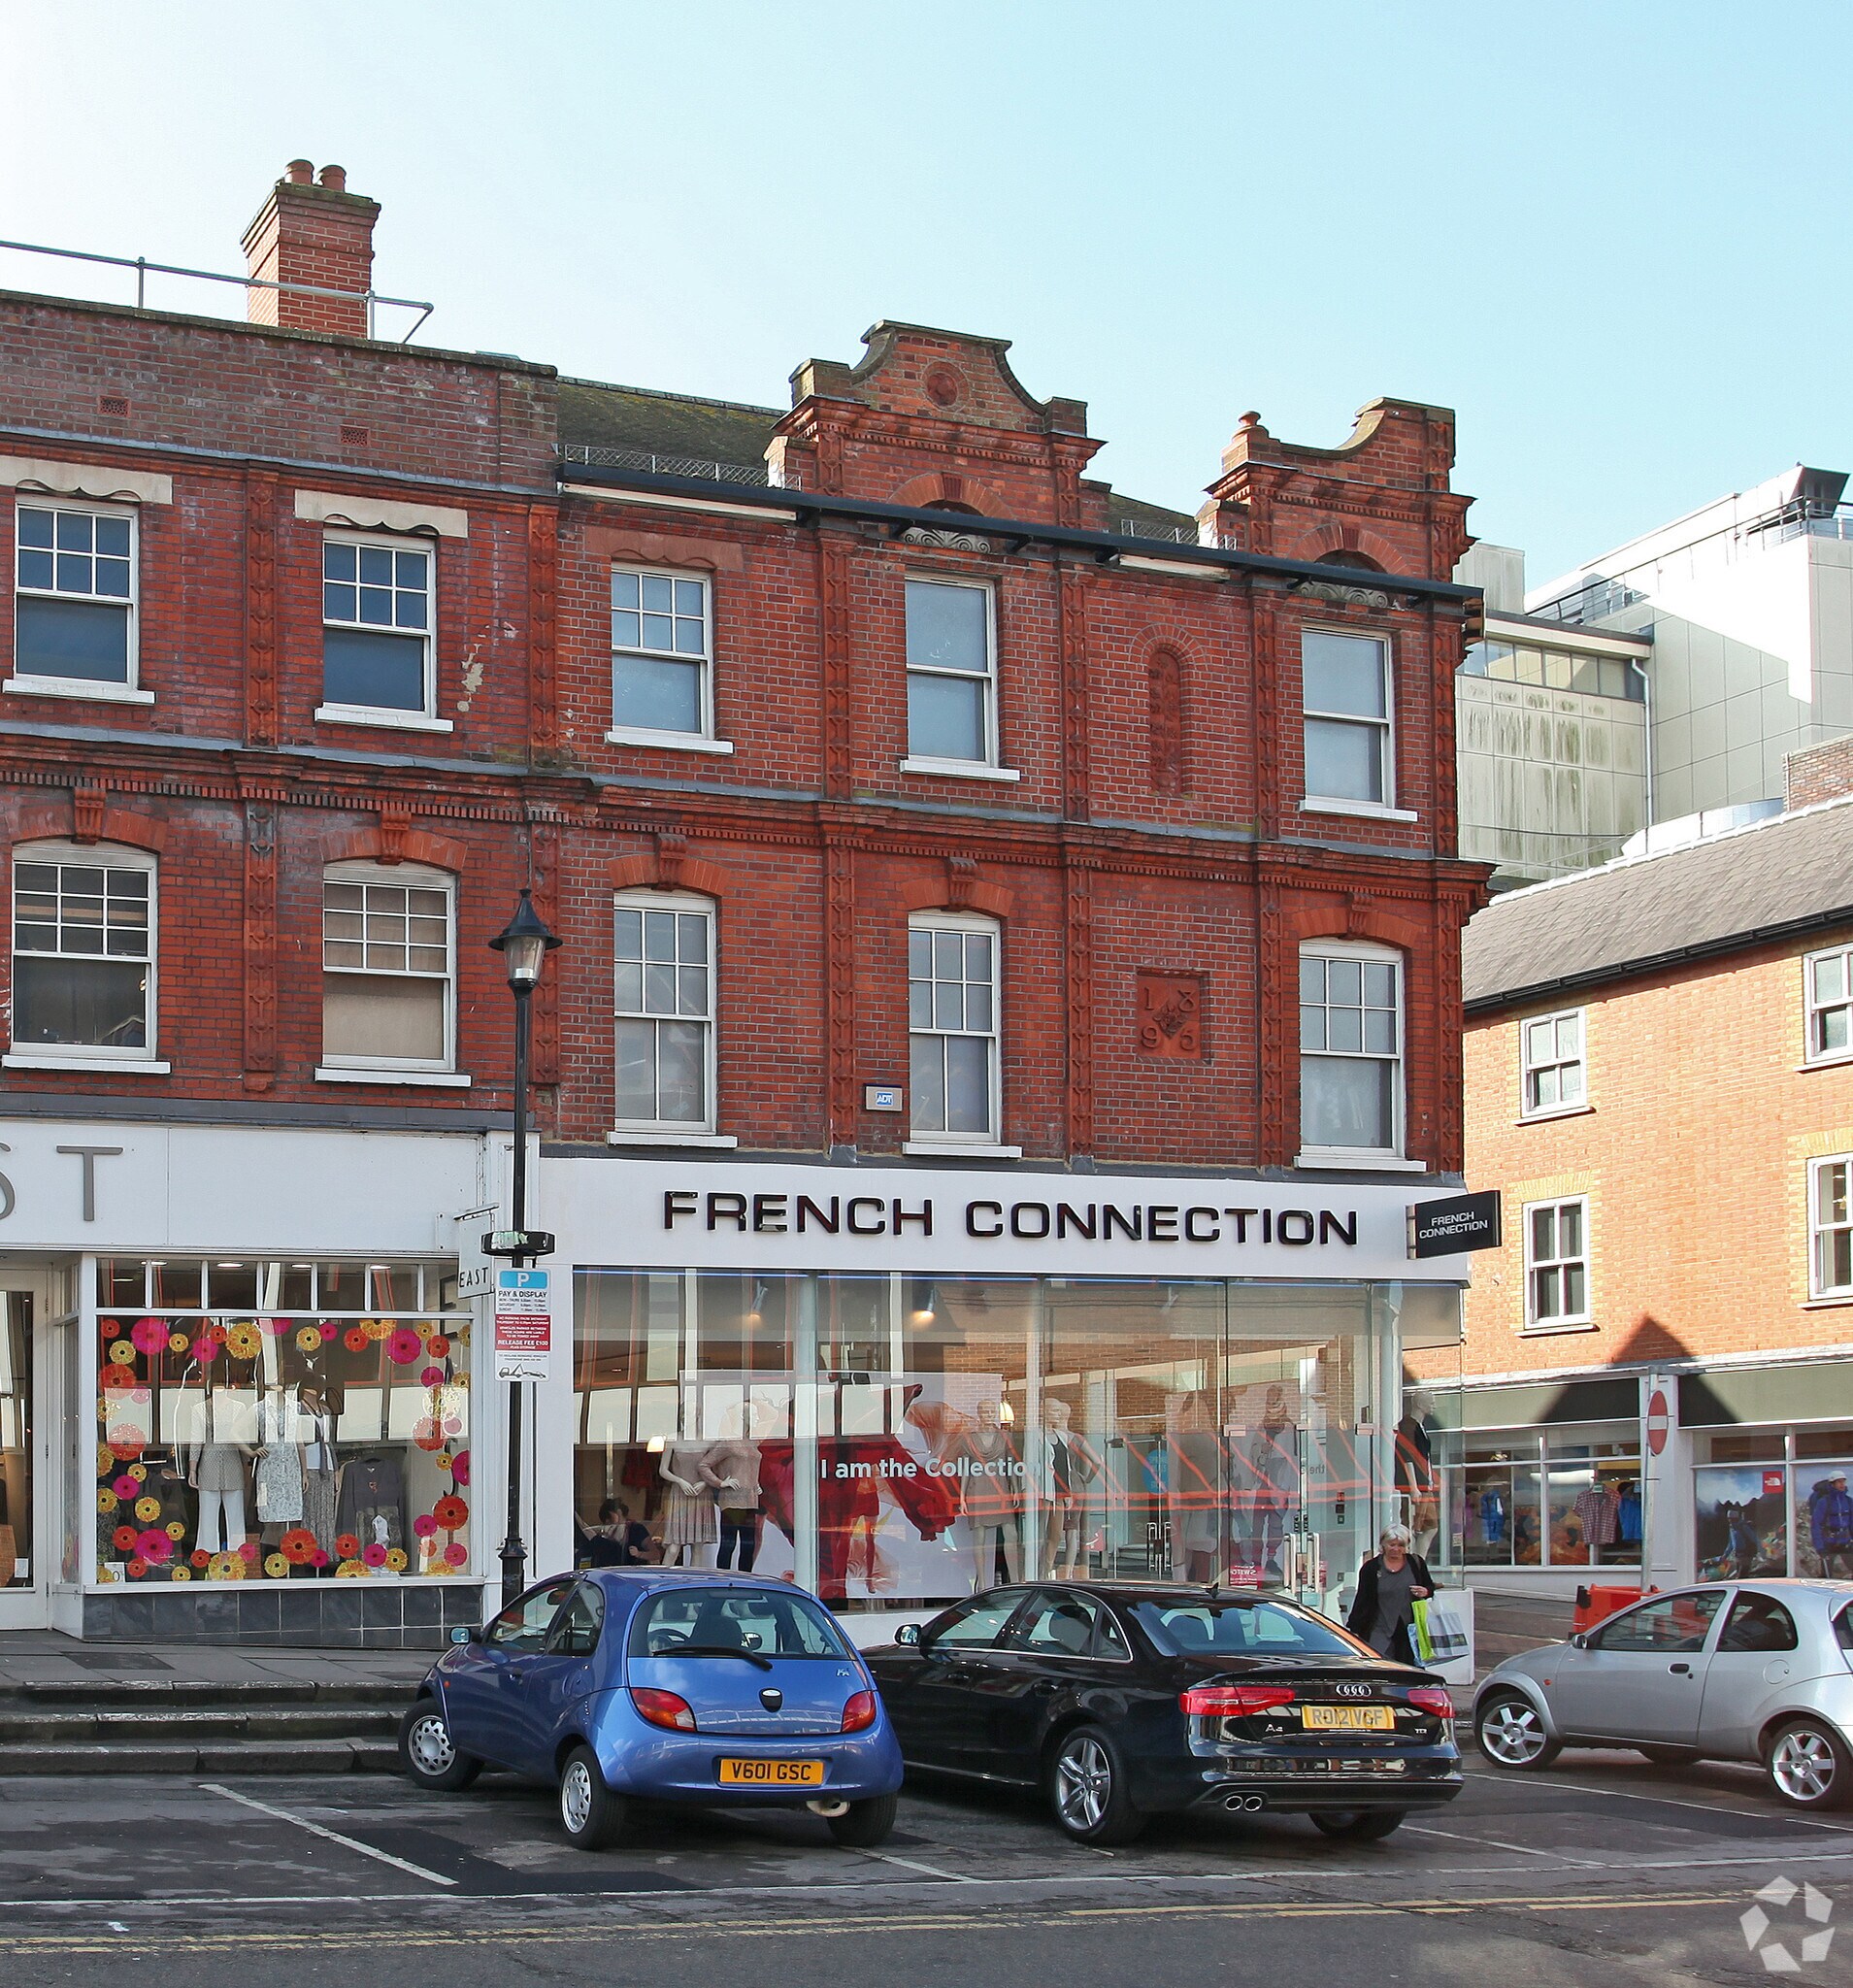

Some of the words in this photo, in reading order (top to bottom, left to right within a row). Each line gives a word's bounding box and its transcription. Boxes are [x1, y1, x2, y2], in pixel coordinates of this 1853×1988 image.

[877, 1095, 892, 1104] ADT
[664, 1190, 933, 1237] FRENCH
[966, 1200, 1358, 1246] CONNECTION
[1431, 1211, 1474, 1226] FRENCH
[1419, 1220, 1488, 1239] CONNECTION
[459, 1267, 488, 1288] EAST
[517, 1272, 530, 1287] P
[821, 1459, 827, 1478] I
[835, 1463, 872, 1478] am
[878, 1457, 917, 1478] the
[732, 1761, 772, 1780] V601
[777, 1763, 812, 1781] GSC
